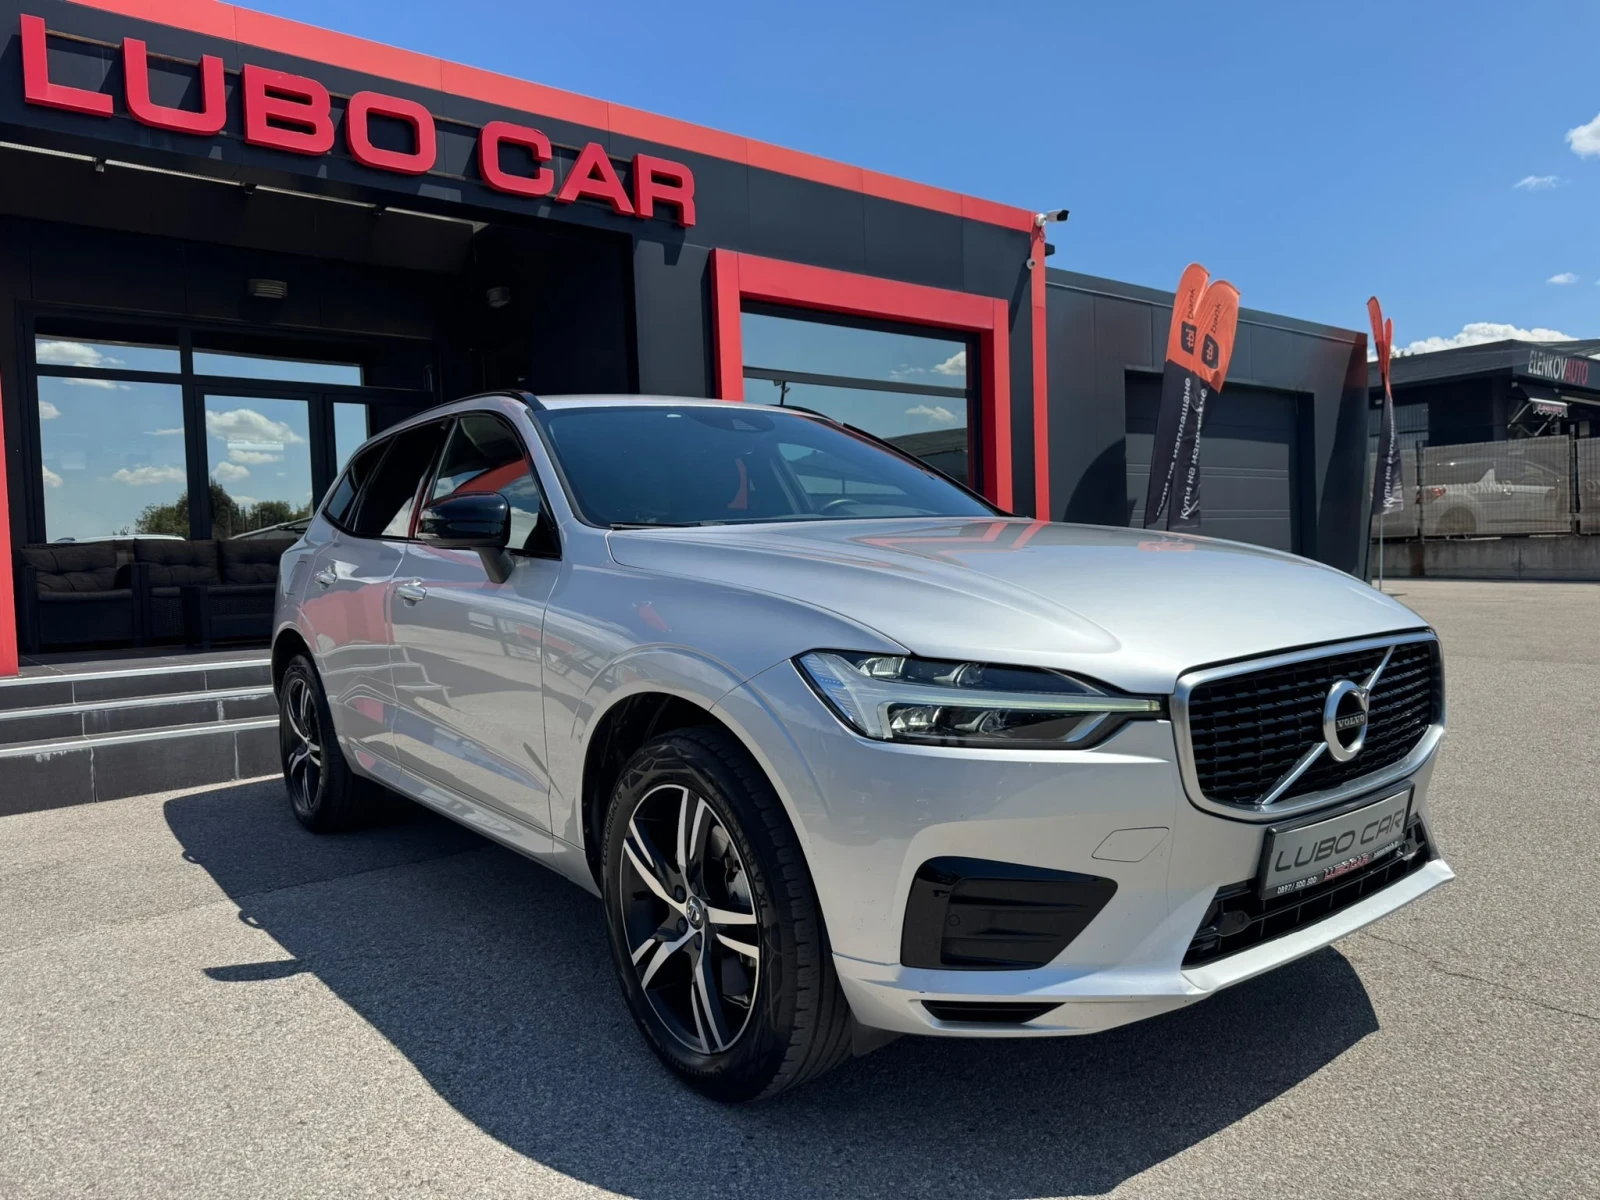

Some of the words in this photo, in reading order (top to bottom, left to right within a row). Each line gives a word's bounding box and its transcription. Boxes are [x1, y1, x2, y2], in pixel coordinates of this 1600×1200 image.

[20, 13, 437, 175] LUBO
[478, 121, 696, 228] CAR
[1188, 287, 1196, 320] bank
[1211, 302, 1221, 334] bank
[1167, 461, 1175, 479] на
[1180, 487, 1193, 520] Купи
[1187, 467, 1196, 484] на
[1336, 714, 1365, 728] VOLVO
[1274, 830, 1356, 872] LUBO
[1360, 807, 1405, 845] CAR
